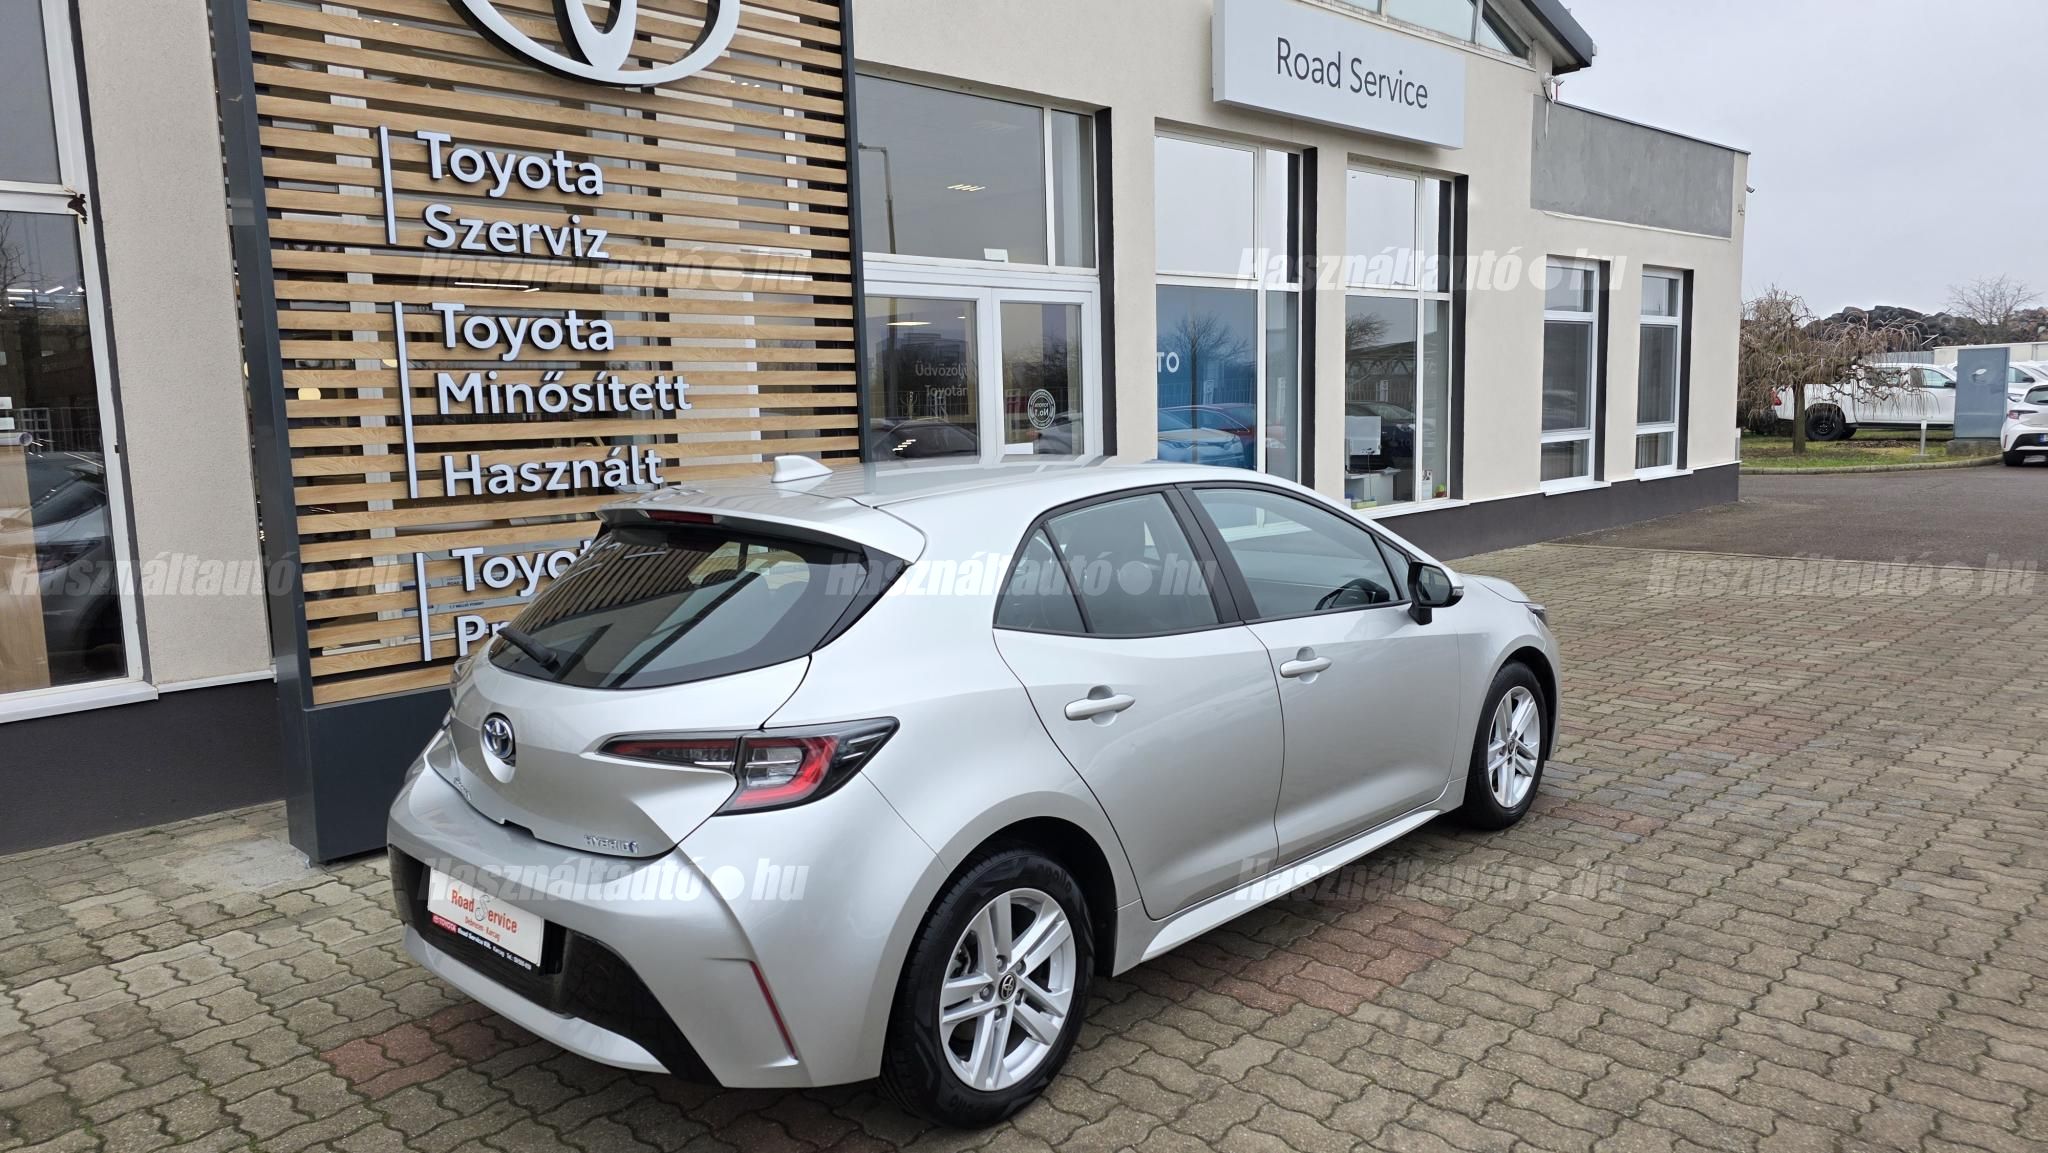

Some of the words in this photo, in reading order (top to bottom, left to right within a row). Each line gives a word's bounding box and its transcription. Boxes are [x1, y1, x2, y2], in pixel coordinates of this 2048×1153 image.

[1277, 37, 1341, 89] Road
[1350, 58, 1428, 109] Service
[416, 130, 604, 198] Toyota
[423, 203, 609, 259] Szerviz
[431, 302, 615, 361] Toyota
[435, 370, 692, 415] Minősített
[442, 445, 664, 497] Használt
[449, 540, 592, 597] Toyo
[451, 889, 475, 913] Road
[475, 894, 518, 934] Service
